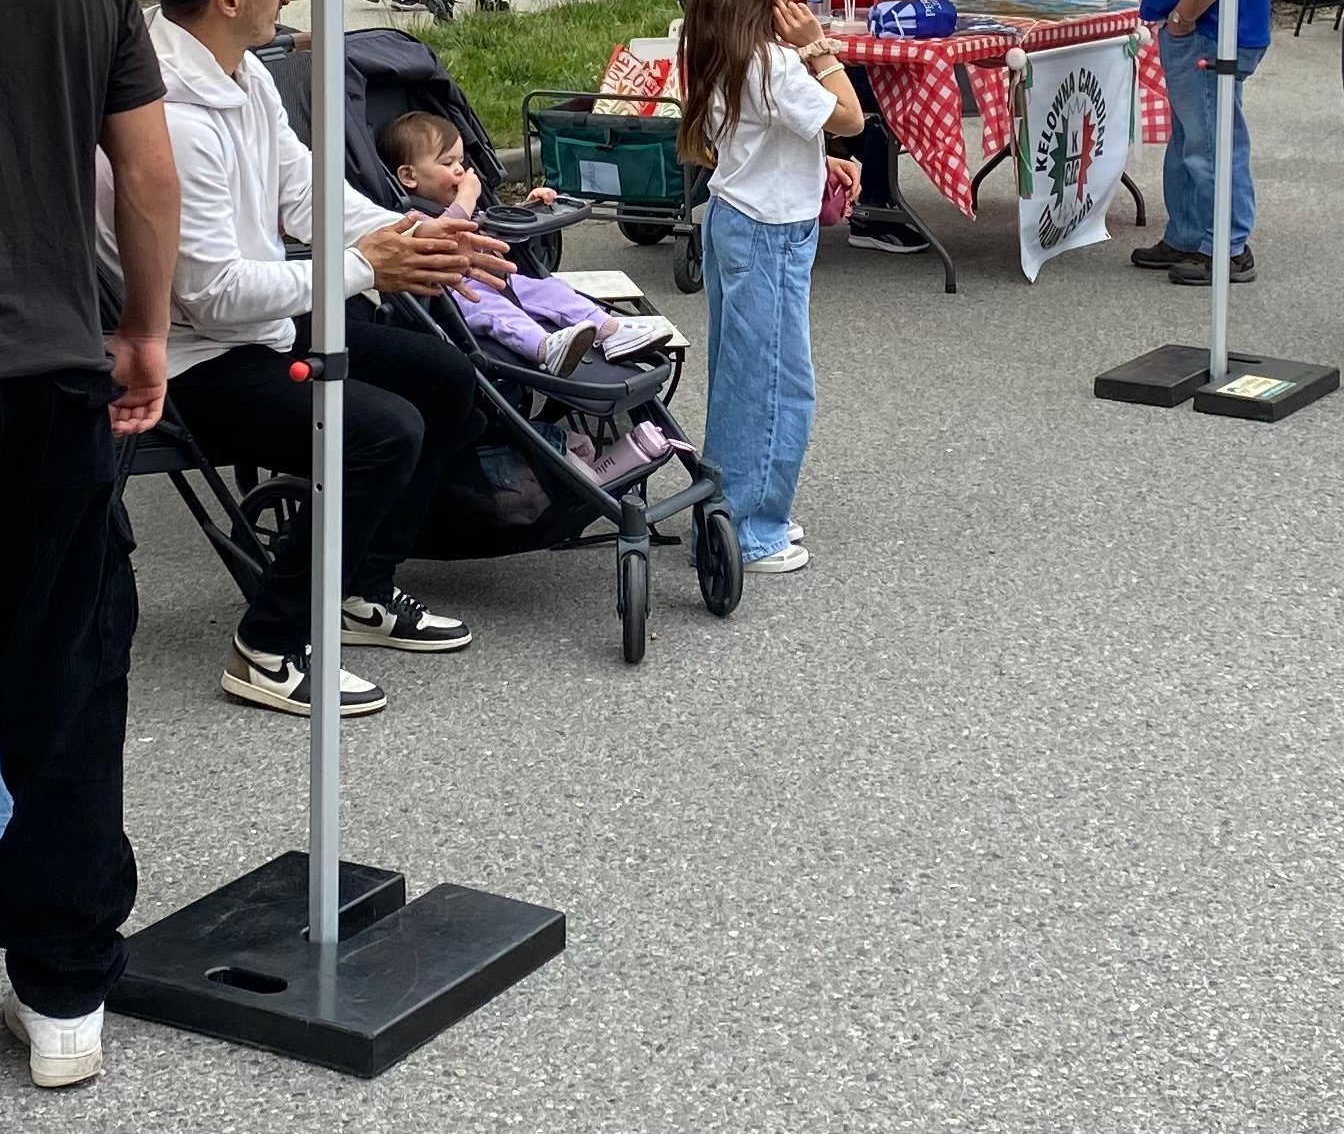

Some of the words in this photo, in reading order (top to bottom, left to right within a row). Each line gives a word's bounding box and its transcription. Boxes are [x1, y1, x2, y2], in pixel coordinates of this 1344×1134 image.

[1035, 71, 1075, 172] KELOWNA
[1078, 67, 1107, 158] CANADIAN
[1071, 130, 1079, 153] K
[1062, 192, 1094, 240] CLUB
